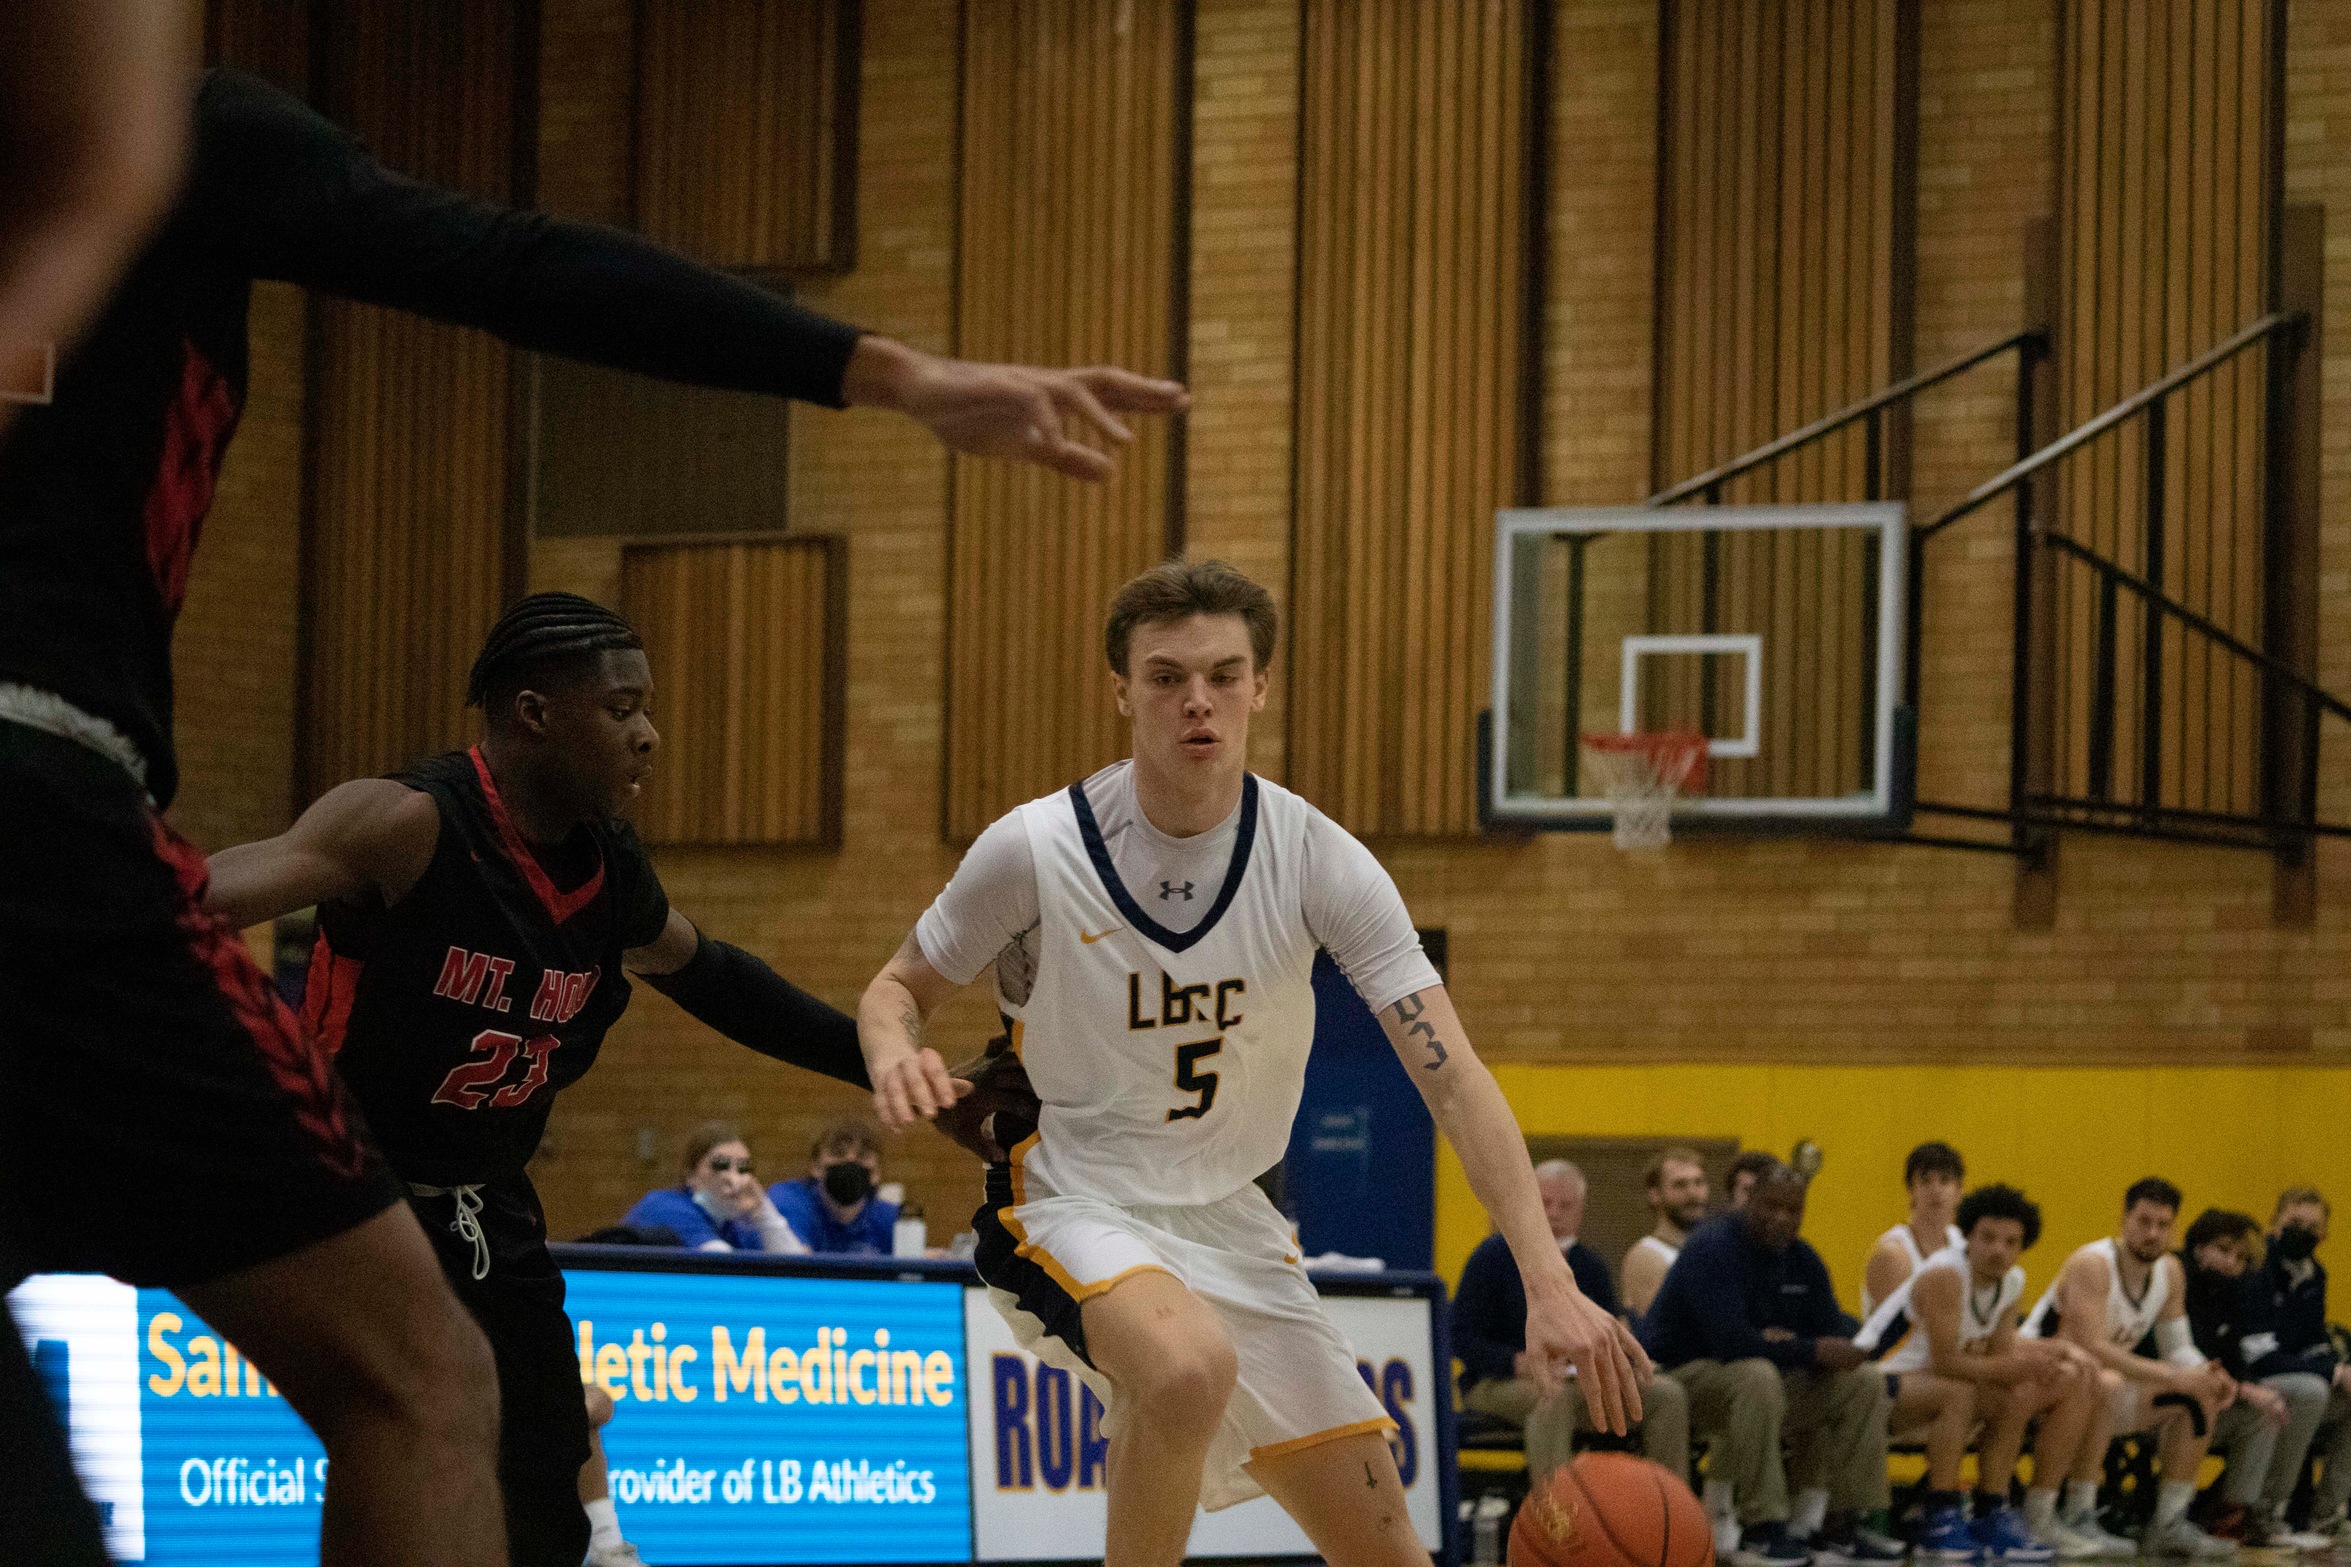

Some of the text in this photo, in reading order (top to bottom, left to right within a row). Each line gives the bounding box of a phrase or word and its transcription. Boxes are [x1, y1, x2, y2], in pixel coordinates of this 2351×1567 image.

[433, 945, 516, 1013] MT.
[431, 1028, 561, 1111] 23
[1164, 1035, 1225, 1124] 5
[578, 1320, 699, 1403] letic
[711, 1325, 954, 1407] Medicine
[179, 1456, 306, 1507] Official
[721, 1457, 756, 1504] of
[762, 1459, 803, 1504] LB
[808, 1457, 937, 1505] Athletics
